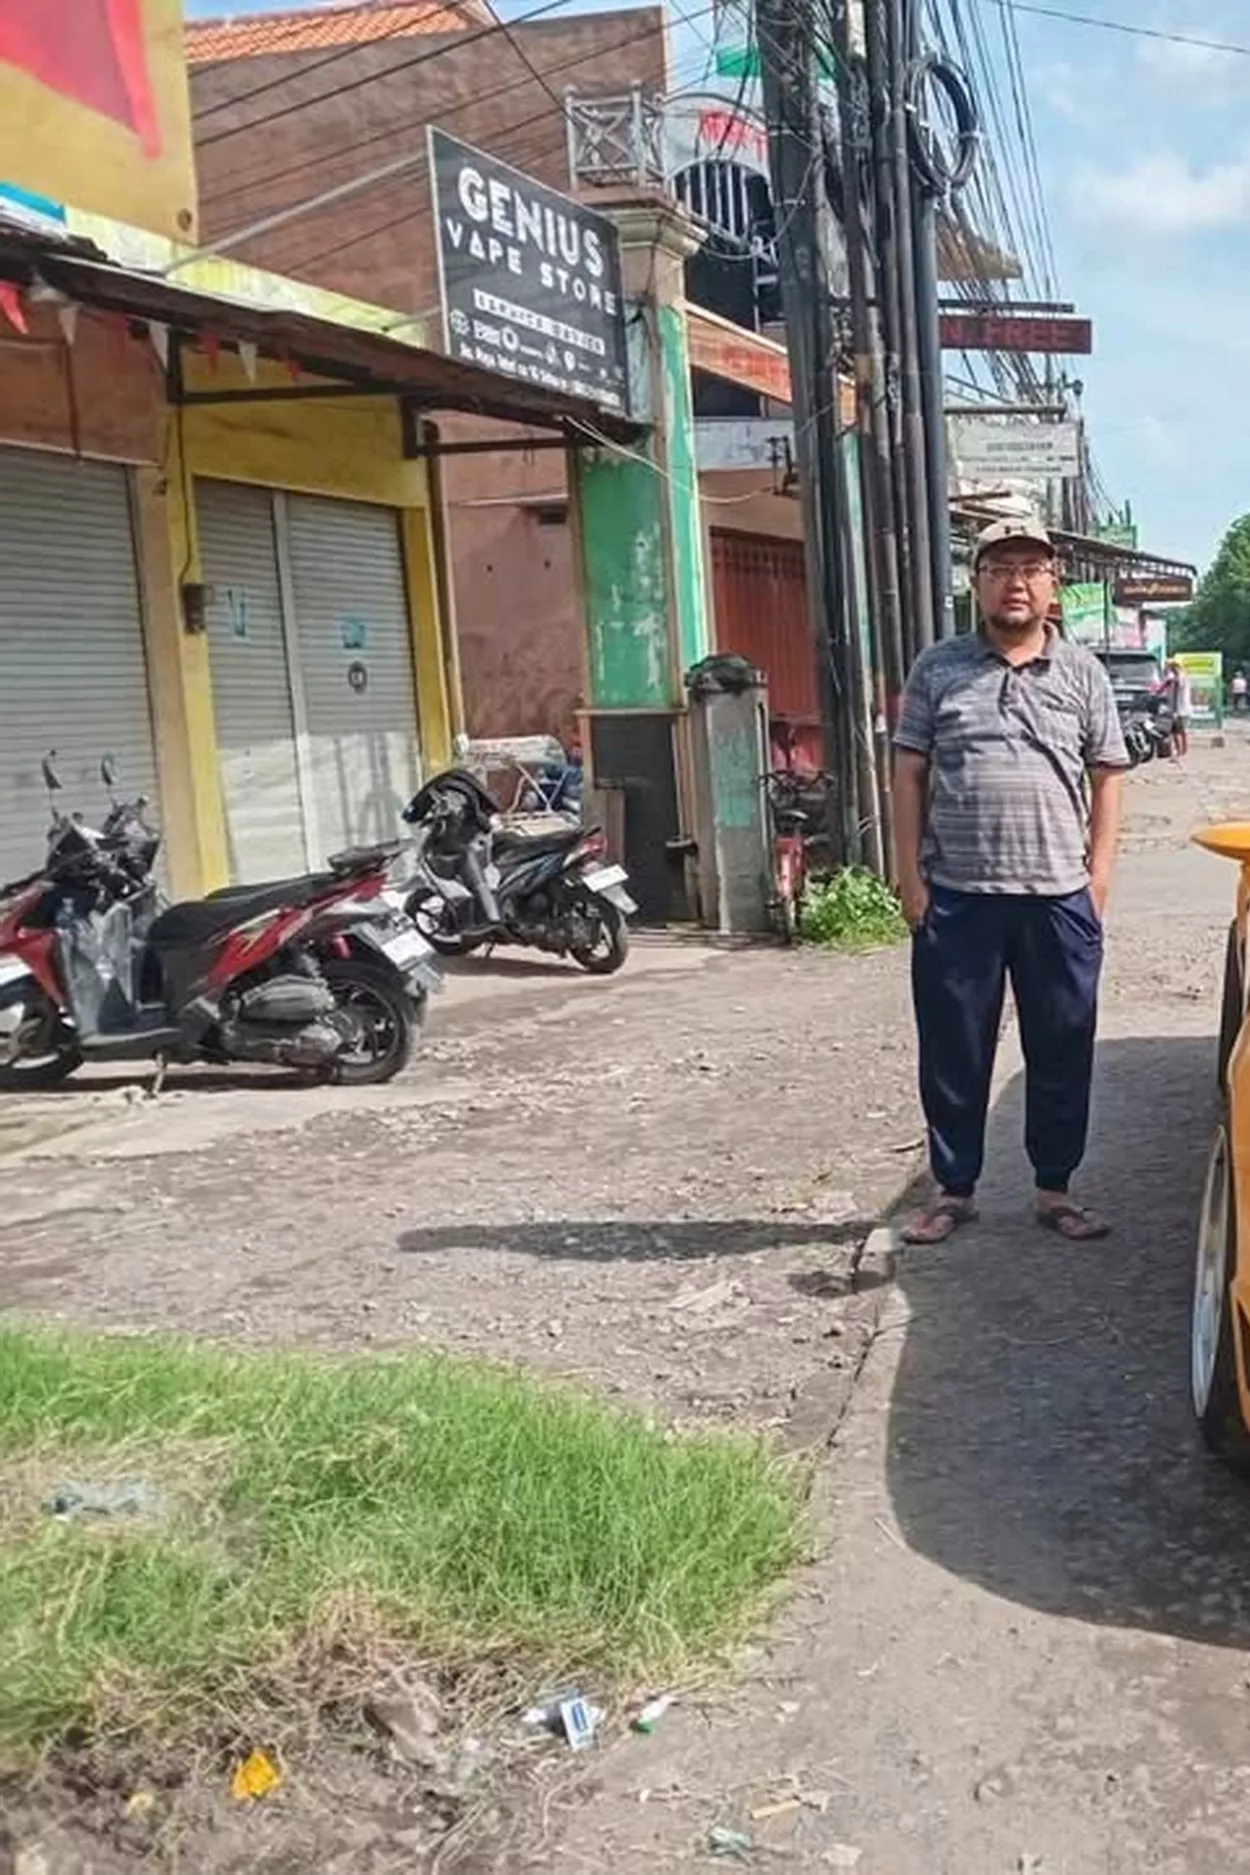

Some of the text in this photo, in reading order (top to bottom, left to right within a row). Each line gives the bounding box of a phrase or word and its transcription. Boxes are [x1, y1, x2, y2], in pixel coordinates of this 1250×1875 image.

[446, 218, 617, 316] VAPE STORE
[458, 167, 604, 278] GENIUS
